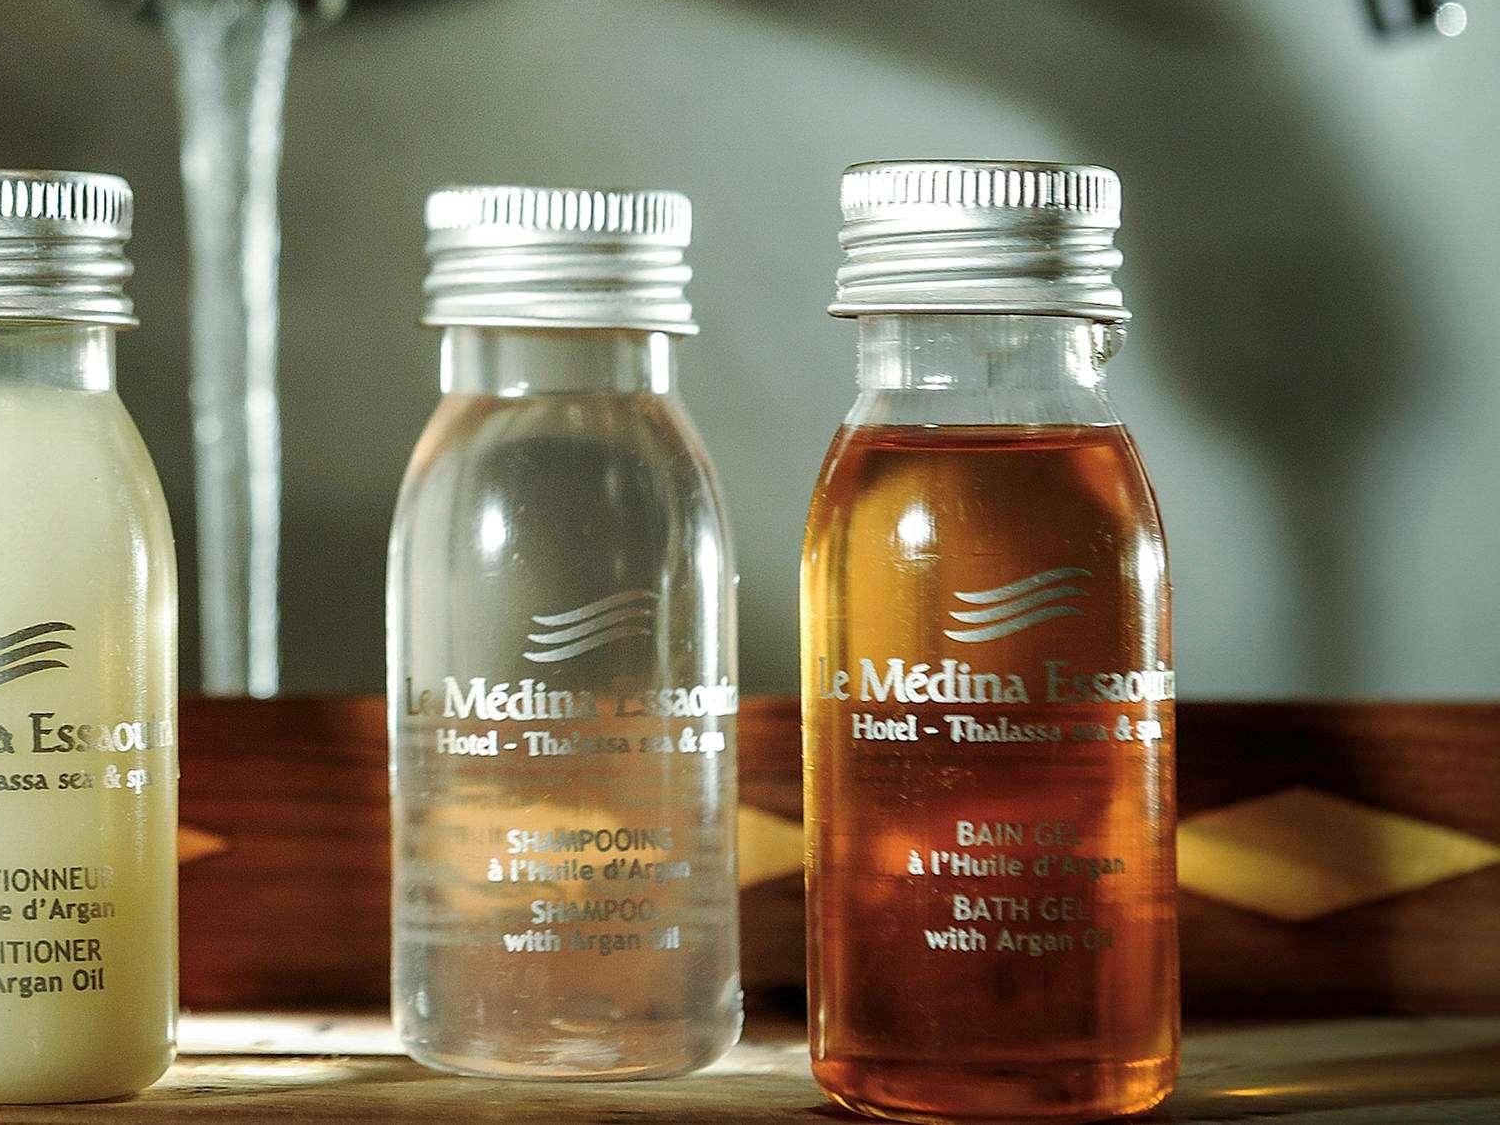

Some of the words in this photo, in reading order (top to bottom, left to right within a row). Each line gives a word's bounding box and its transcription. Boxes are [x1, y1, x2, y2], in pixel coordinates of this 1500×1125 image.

[819, 656, 850, 700] Le
[860, 658, 1031, 704] Médina
[443, 676, 596, 721] Médina
[436, 728, 498, 756] Hotel
[678, 726, 698, 753] &
[852, 713, 919, 741] Hotel
[943, 714, 1062, 743] Thalassa
[1114, 714, 1134, 741] &
[58, 771, 94, 790] sea
[104, 764, 122, 789] &
[506, 827, 674, 855] SHAMPOOING
[956, 820, 1024, 847] BAIN
[1034, 822, 1083, 847] GEL
[487, 857, 504, 882] à
[907, 849, 925, 875] à
[531, 898, 656, 924] SHAMPOO
[953, 893, 1030, 922] BATH
[1040, 896, 1091, 922] GEL
[503, 929, 561, 953] with
[570, 930, 641, 956] Argan
[924, 926, 987, 952] with
[997, 927, 1074, 957] Argan
[72, 968, 104, 991] Oil
